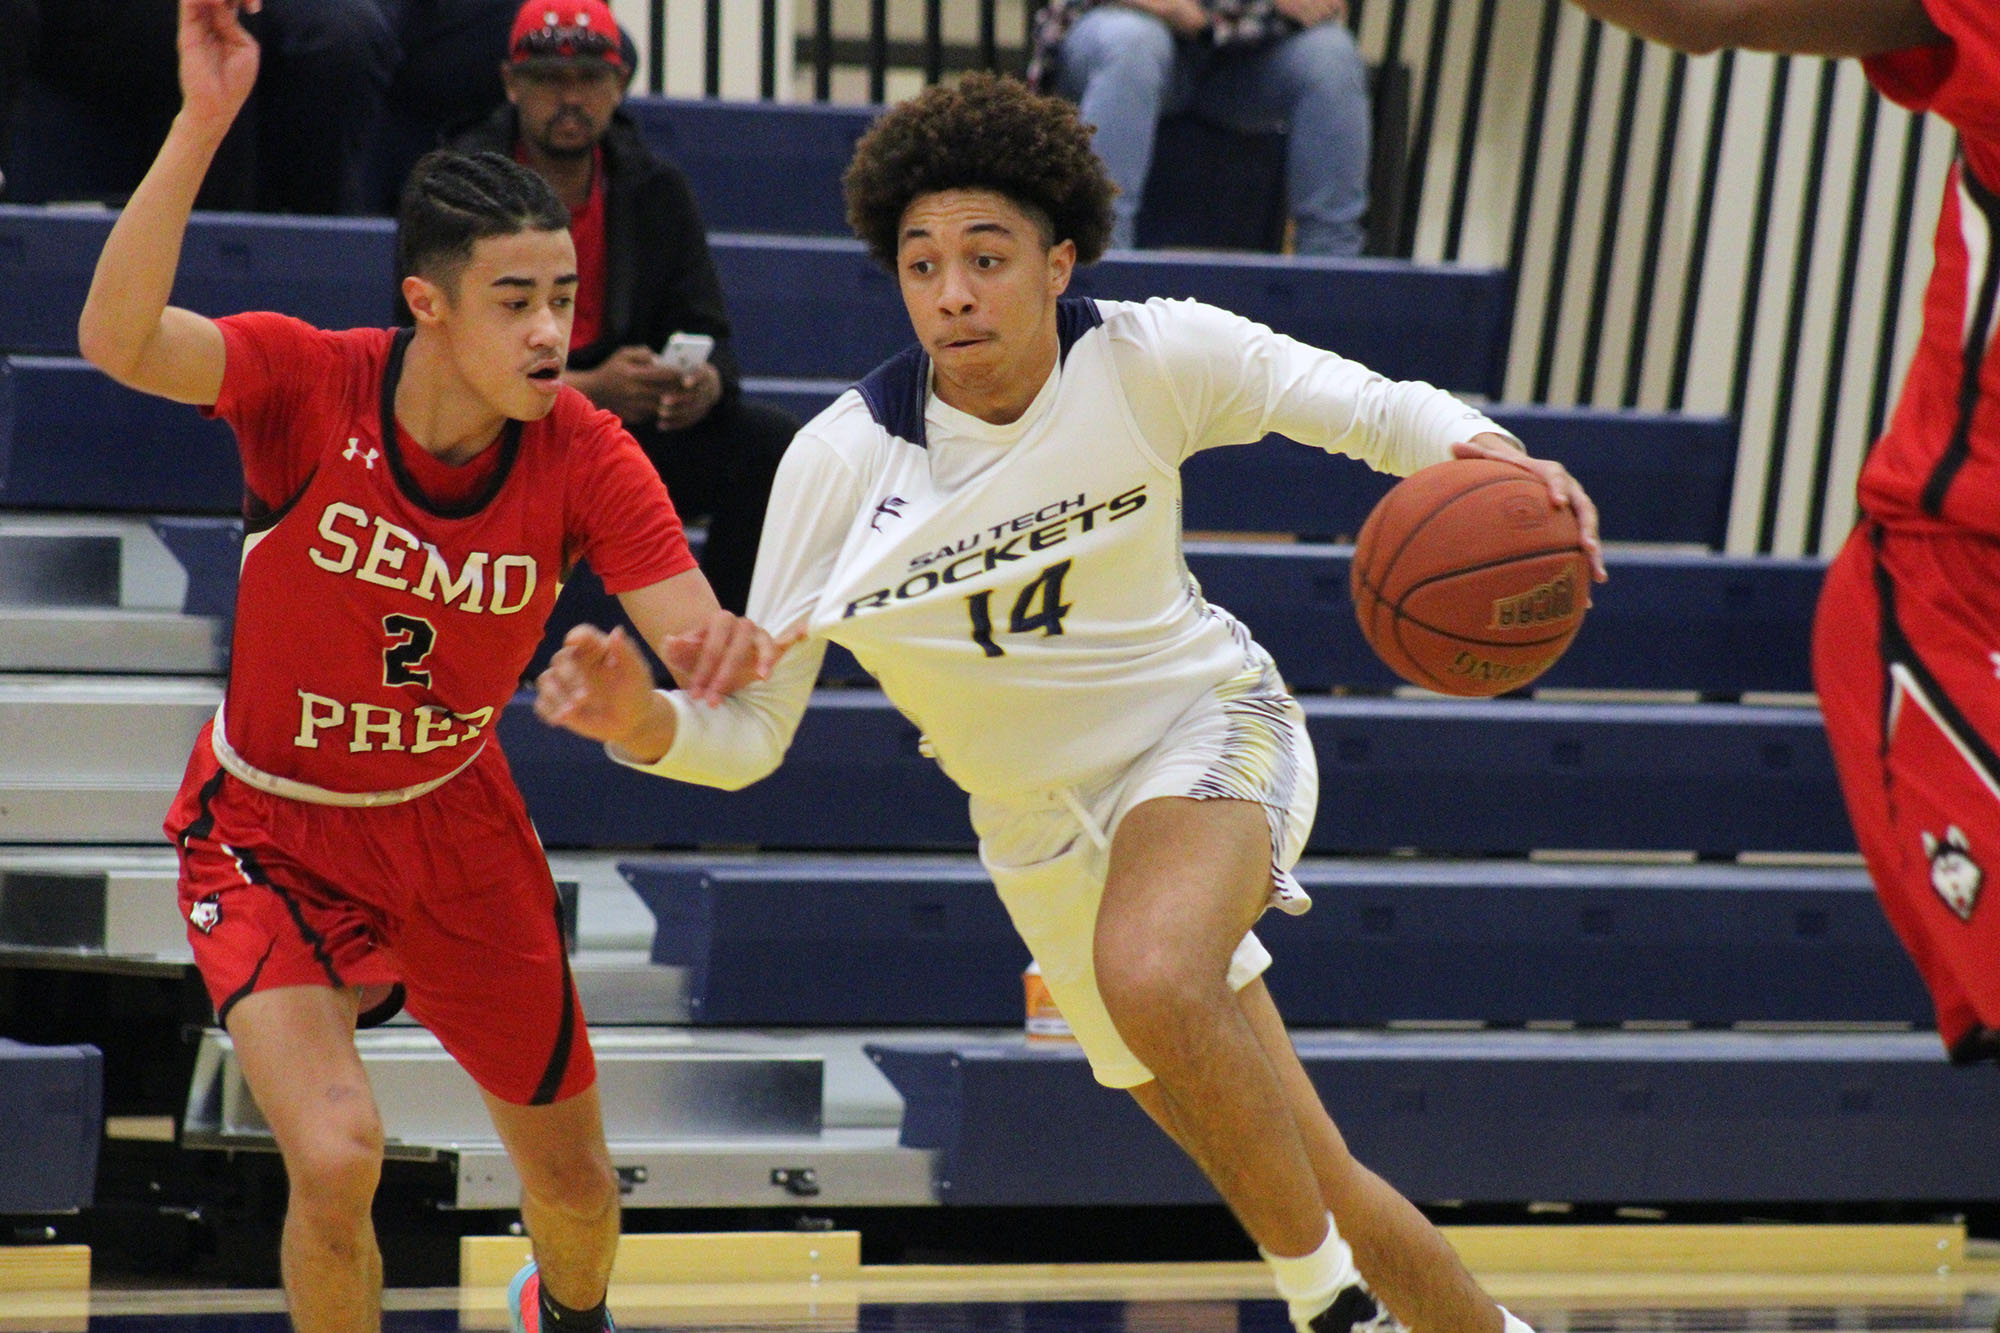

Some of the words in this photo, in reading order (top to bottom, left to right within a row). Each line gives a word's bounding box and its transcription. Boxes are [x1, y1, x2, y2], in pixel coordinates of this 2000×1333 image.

[307, 501, 537, 615] SEMO
[842, 484, 1148, 619] ROCKETS
[907, 533, 981, 572] SAU
[986, 492, 1086, 540] TECH
[381, 612, 437, 690] 2
[965, 558, 1073, 658] 14
